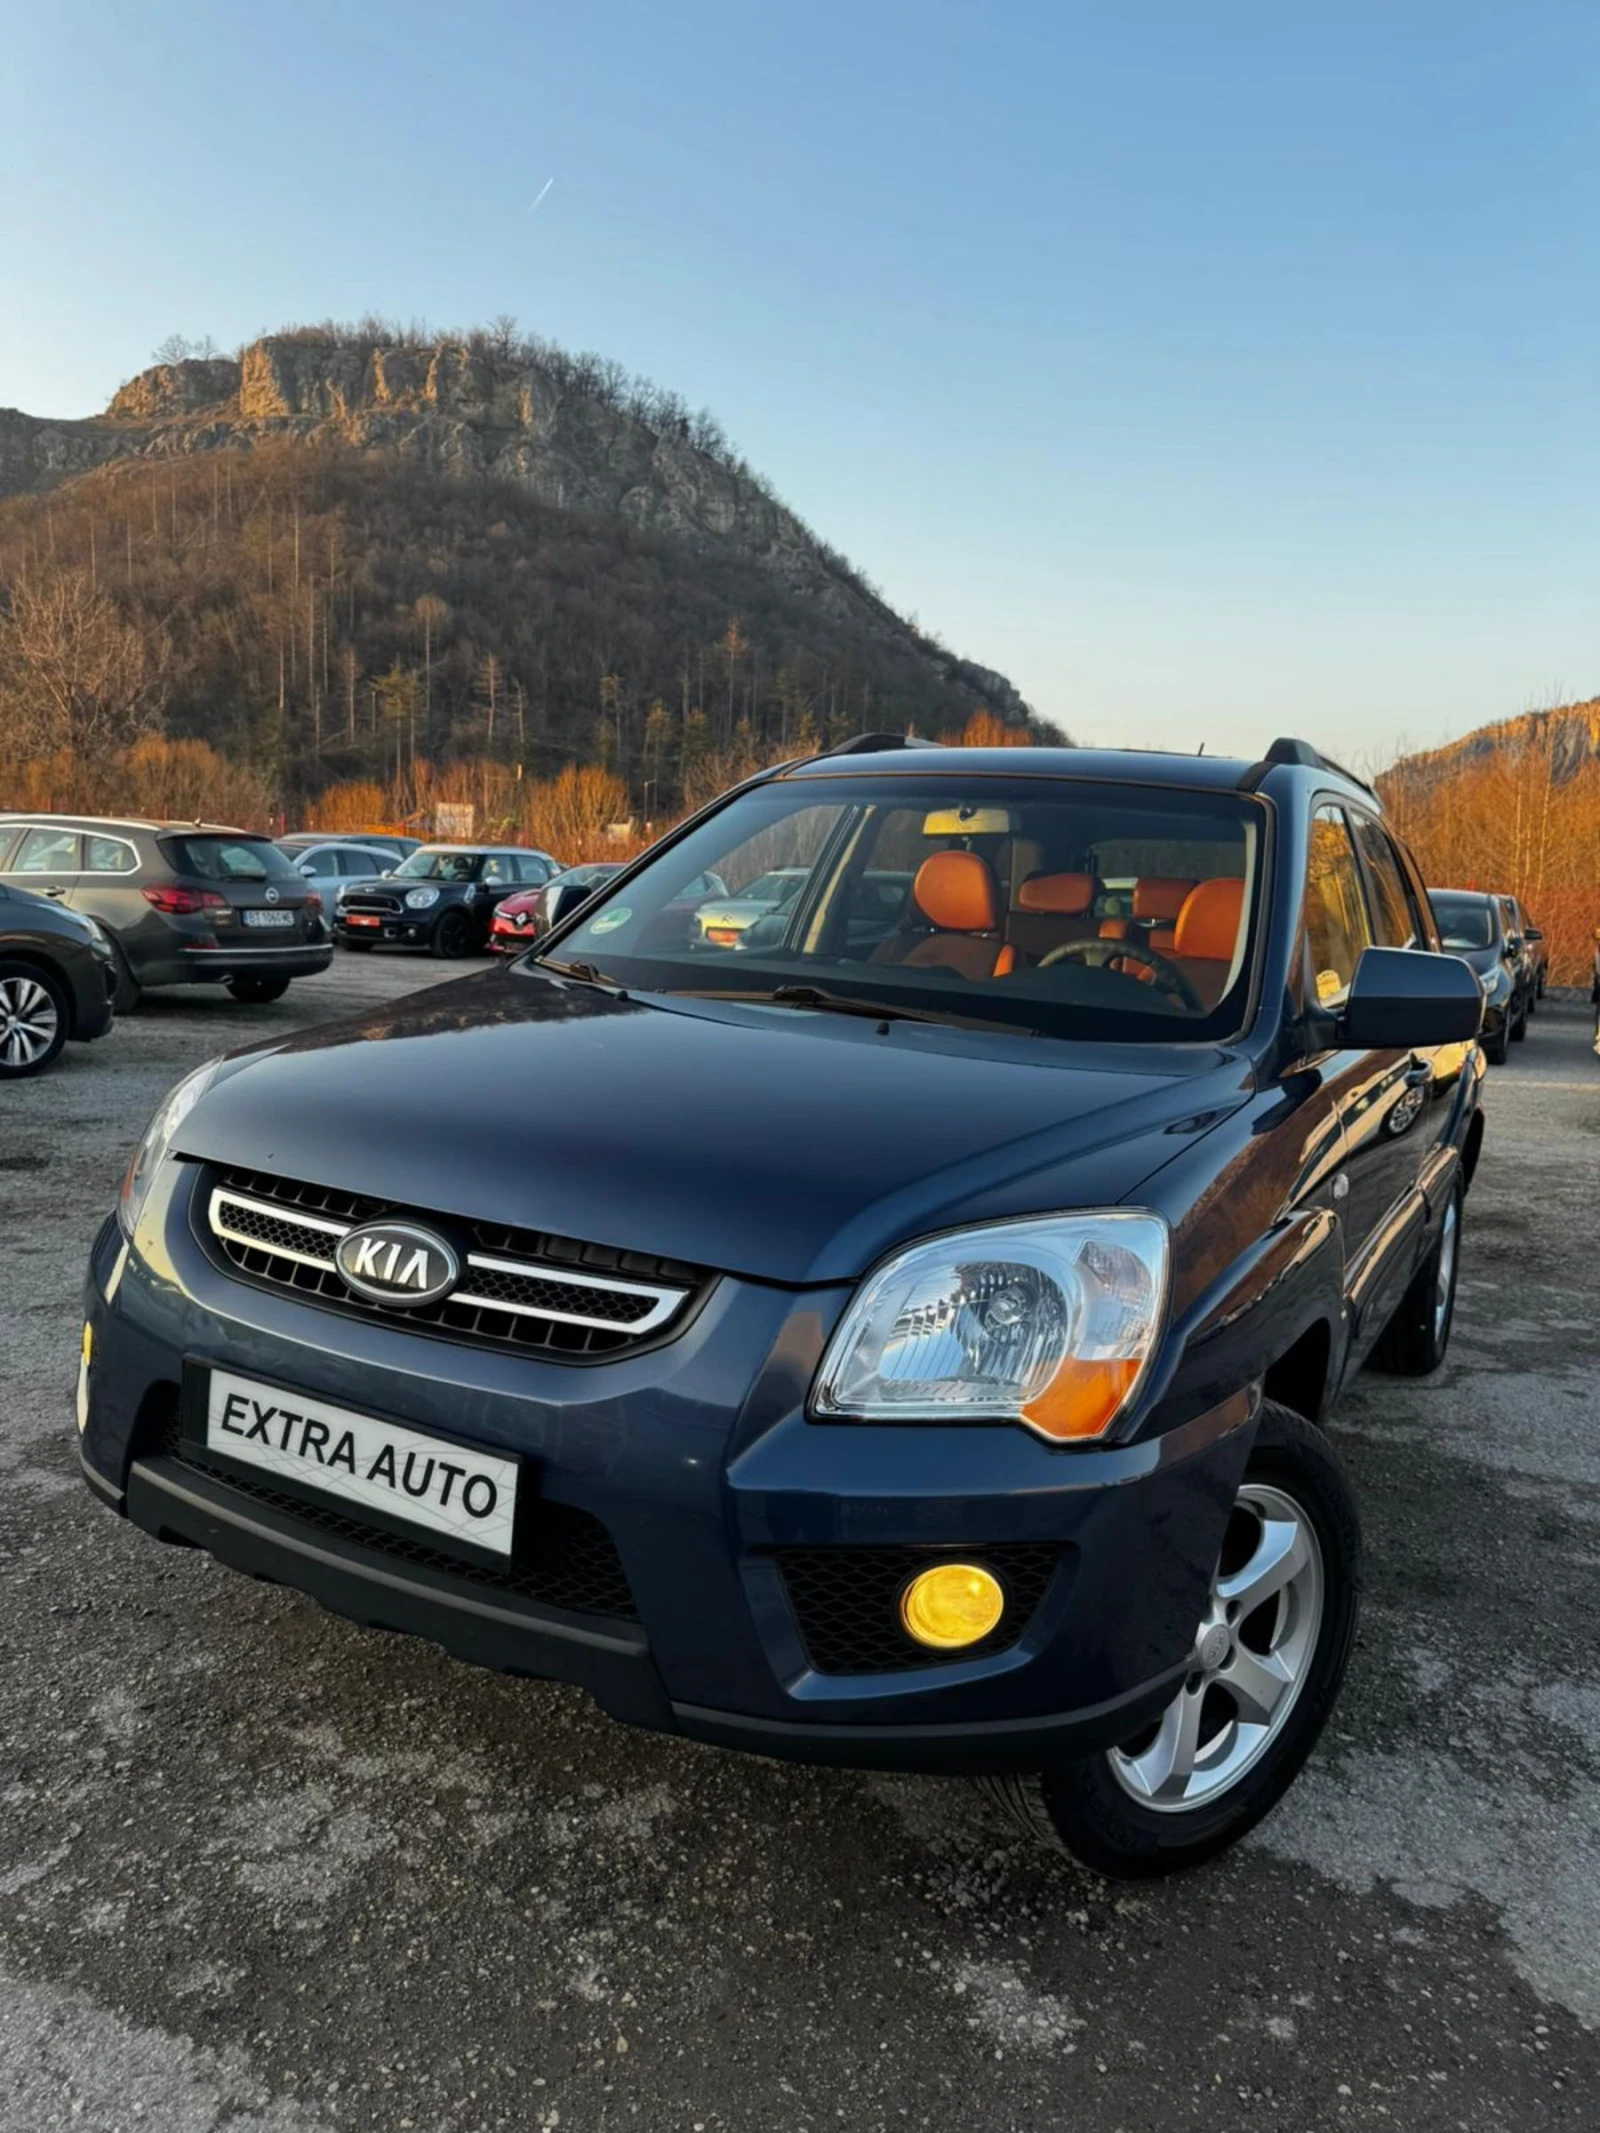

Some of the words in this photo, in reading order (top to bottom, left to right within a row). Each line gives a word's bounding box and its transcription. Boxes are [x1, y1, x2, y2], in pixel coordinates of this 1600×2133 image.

[354, 1237, 428, 1290] KIA
[221, 1392, 356, 1474] EXTRA
[367, 1444, 498, 1519] AUTO
